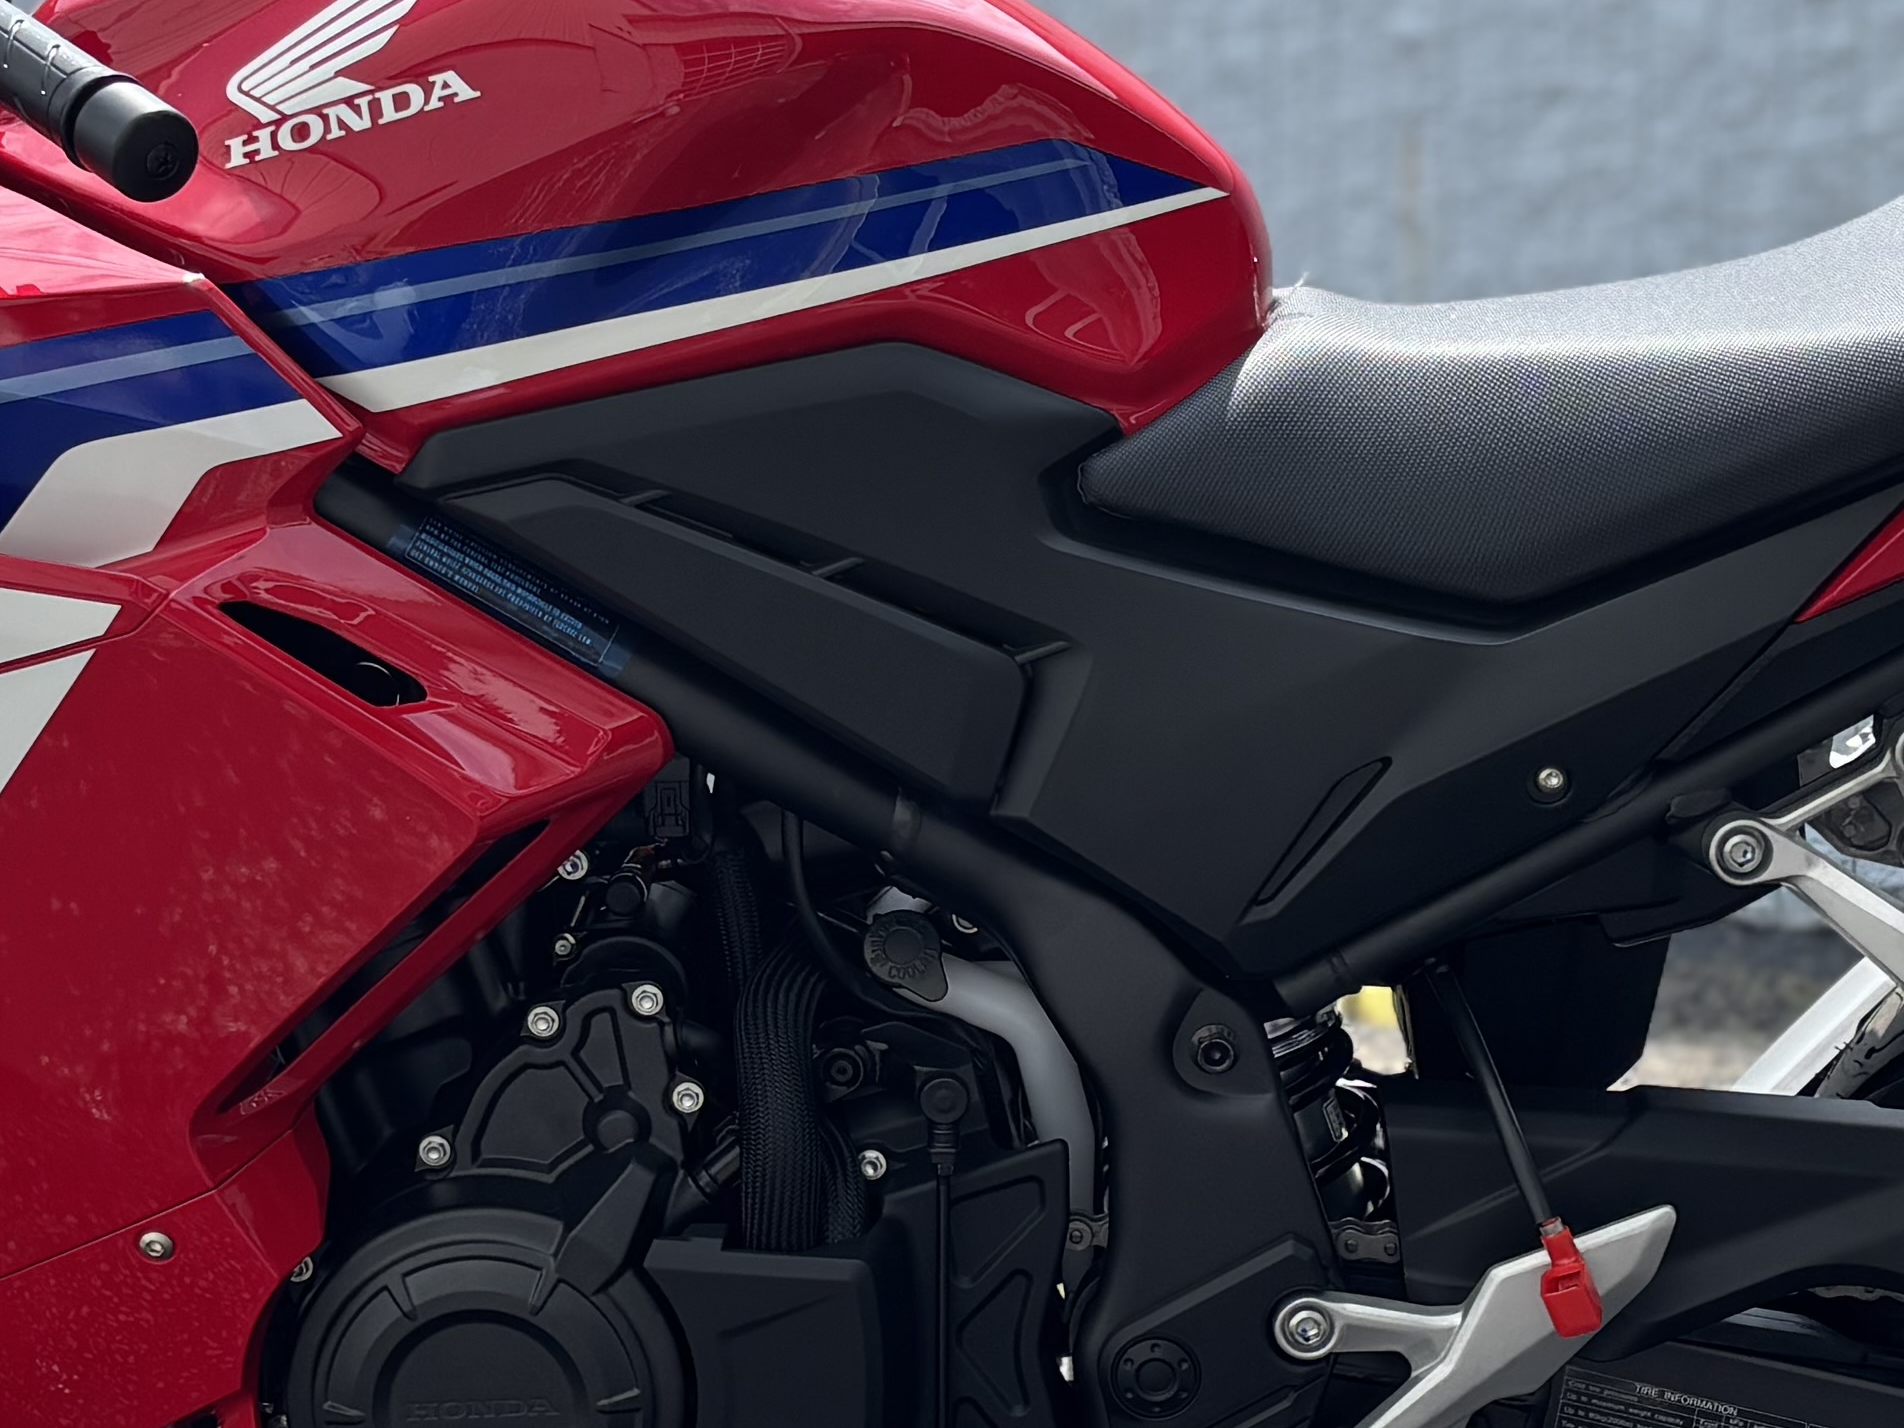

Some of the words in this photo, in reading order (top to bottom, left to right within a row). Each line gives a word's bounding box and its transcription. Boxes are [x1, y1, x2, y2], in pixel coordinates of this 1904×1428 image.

[224, 70, 481, 169] HONDA
[407, 1398, 561, 1422] HONDA
[1635, 1384, 1659, 1399] TIRE
[1664, 1390, 1738, 1417] INFORMATION
